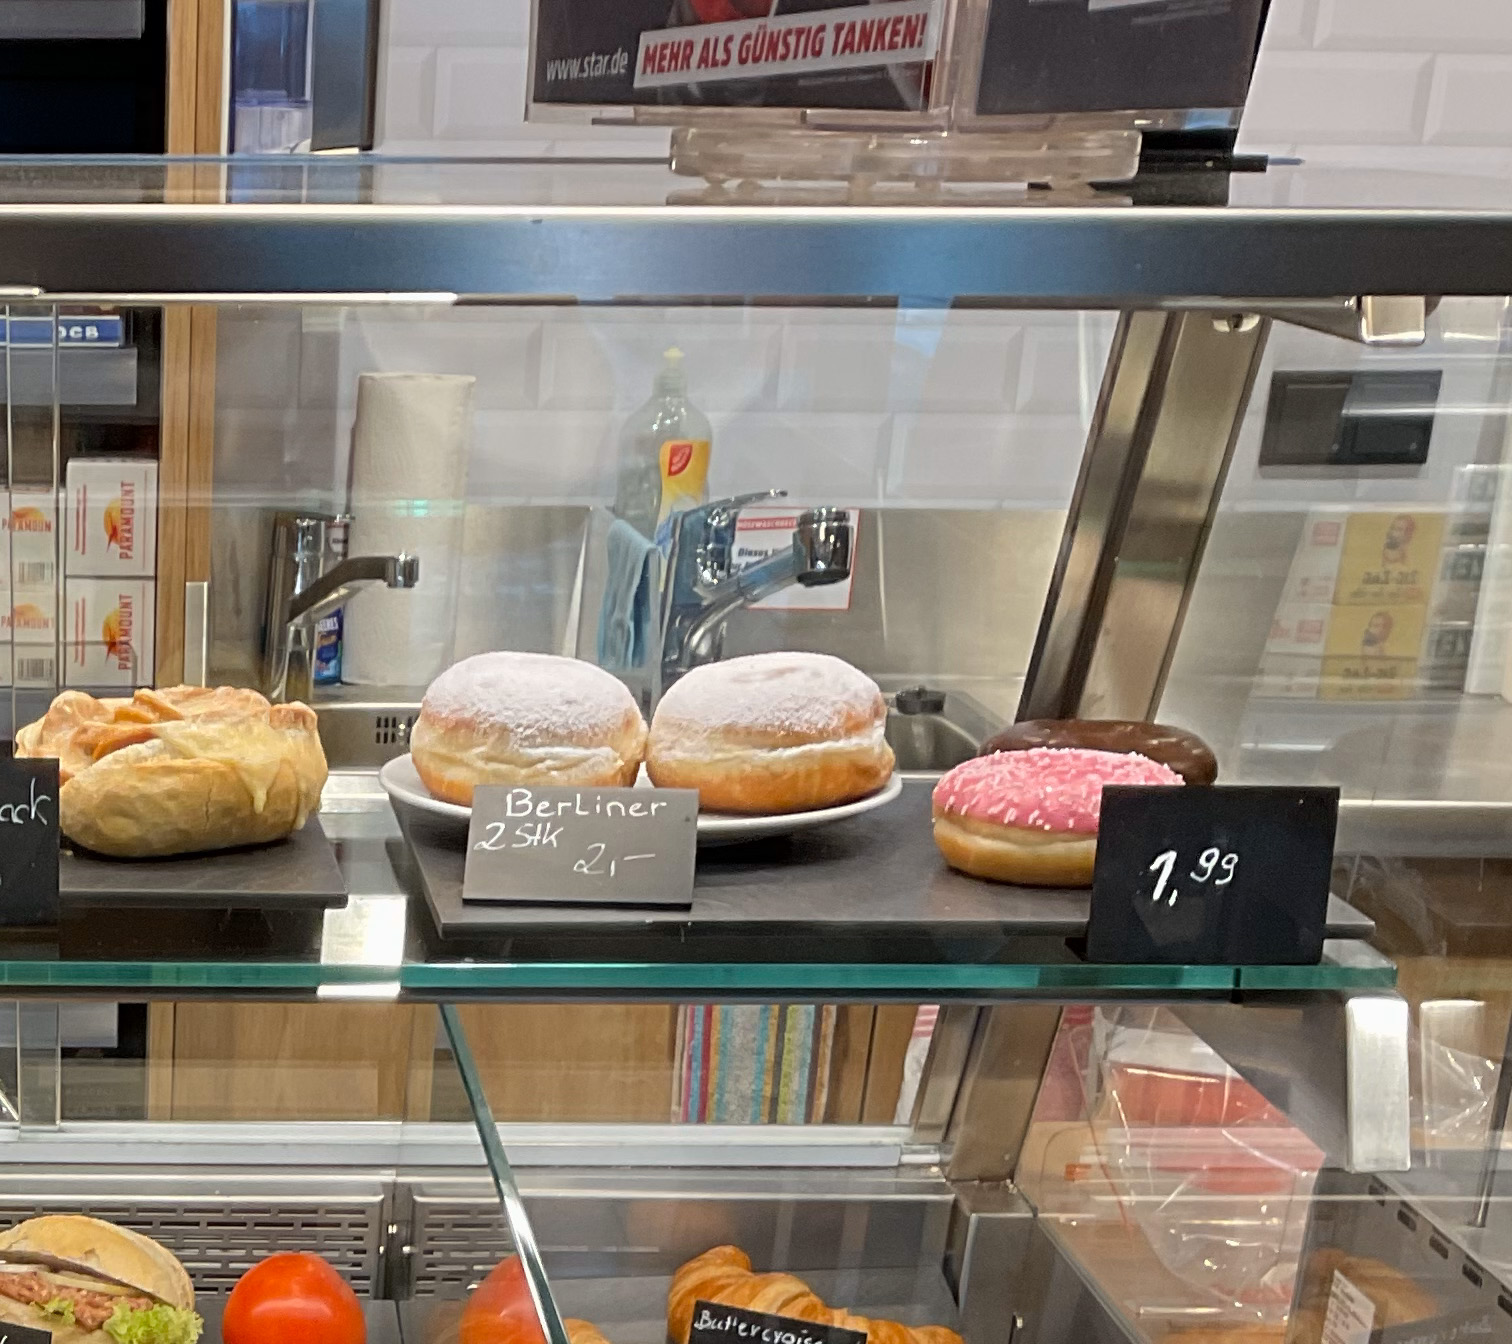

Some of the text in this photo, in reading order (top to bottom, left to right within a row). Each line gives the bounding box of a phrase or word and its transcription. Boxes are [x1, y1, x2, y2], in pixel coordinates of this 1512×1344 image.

[545, 47, 629, 83] www.star.de
[640, 12, 929, 75] MEHR ALS GÜNSTIG TANKEN!
[119, 481, 135, 560] PARAMOUNT
[118, 594, 134, 671] PARAMOUNT
[473, 821, 506, 851] 2
[1149, 847, 1239, 907] 1,99
